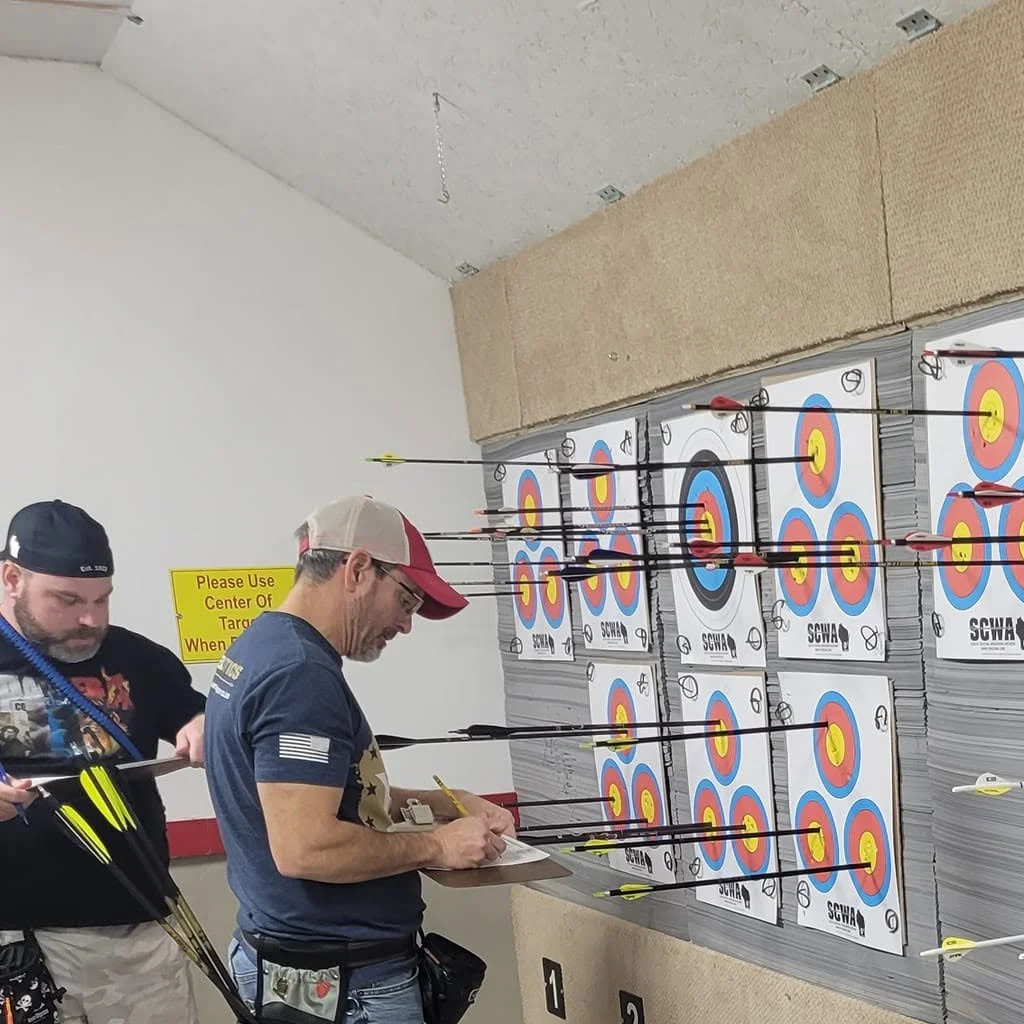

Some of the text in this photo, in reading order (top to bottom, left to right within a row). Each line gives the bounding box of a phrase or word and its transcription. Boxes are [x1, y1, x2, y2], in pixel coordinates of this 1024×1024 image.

[196, 574, 275, 589] Please Use
[205, 594, 272, 610] Center Of
[218, 616, 255, 632] Targ
[601, 621, 621, 638] SCWA
[807, 622, 838, 643] SCWA
[969, 617, 1015, 641] SCWA
[185, 638, 226, 652] When
[702, 632, 728, 651] SCWA
[625, 847, 646, 867] SCWA
[719, 881, 742, 900] SCWA
[827, 900, 856, 927] SCWA
[549, 969, 559, 1009] 1
